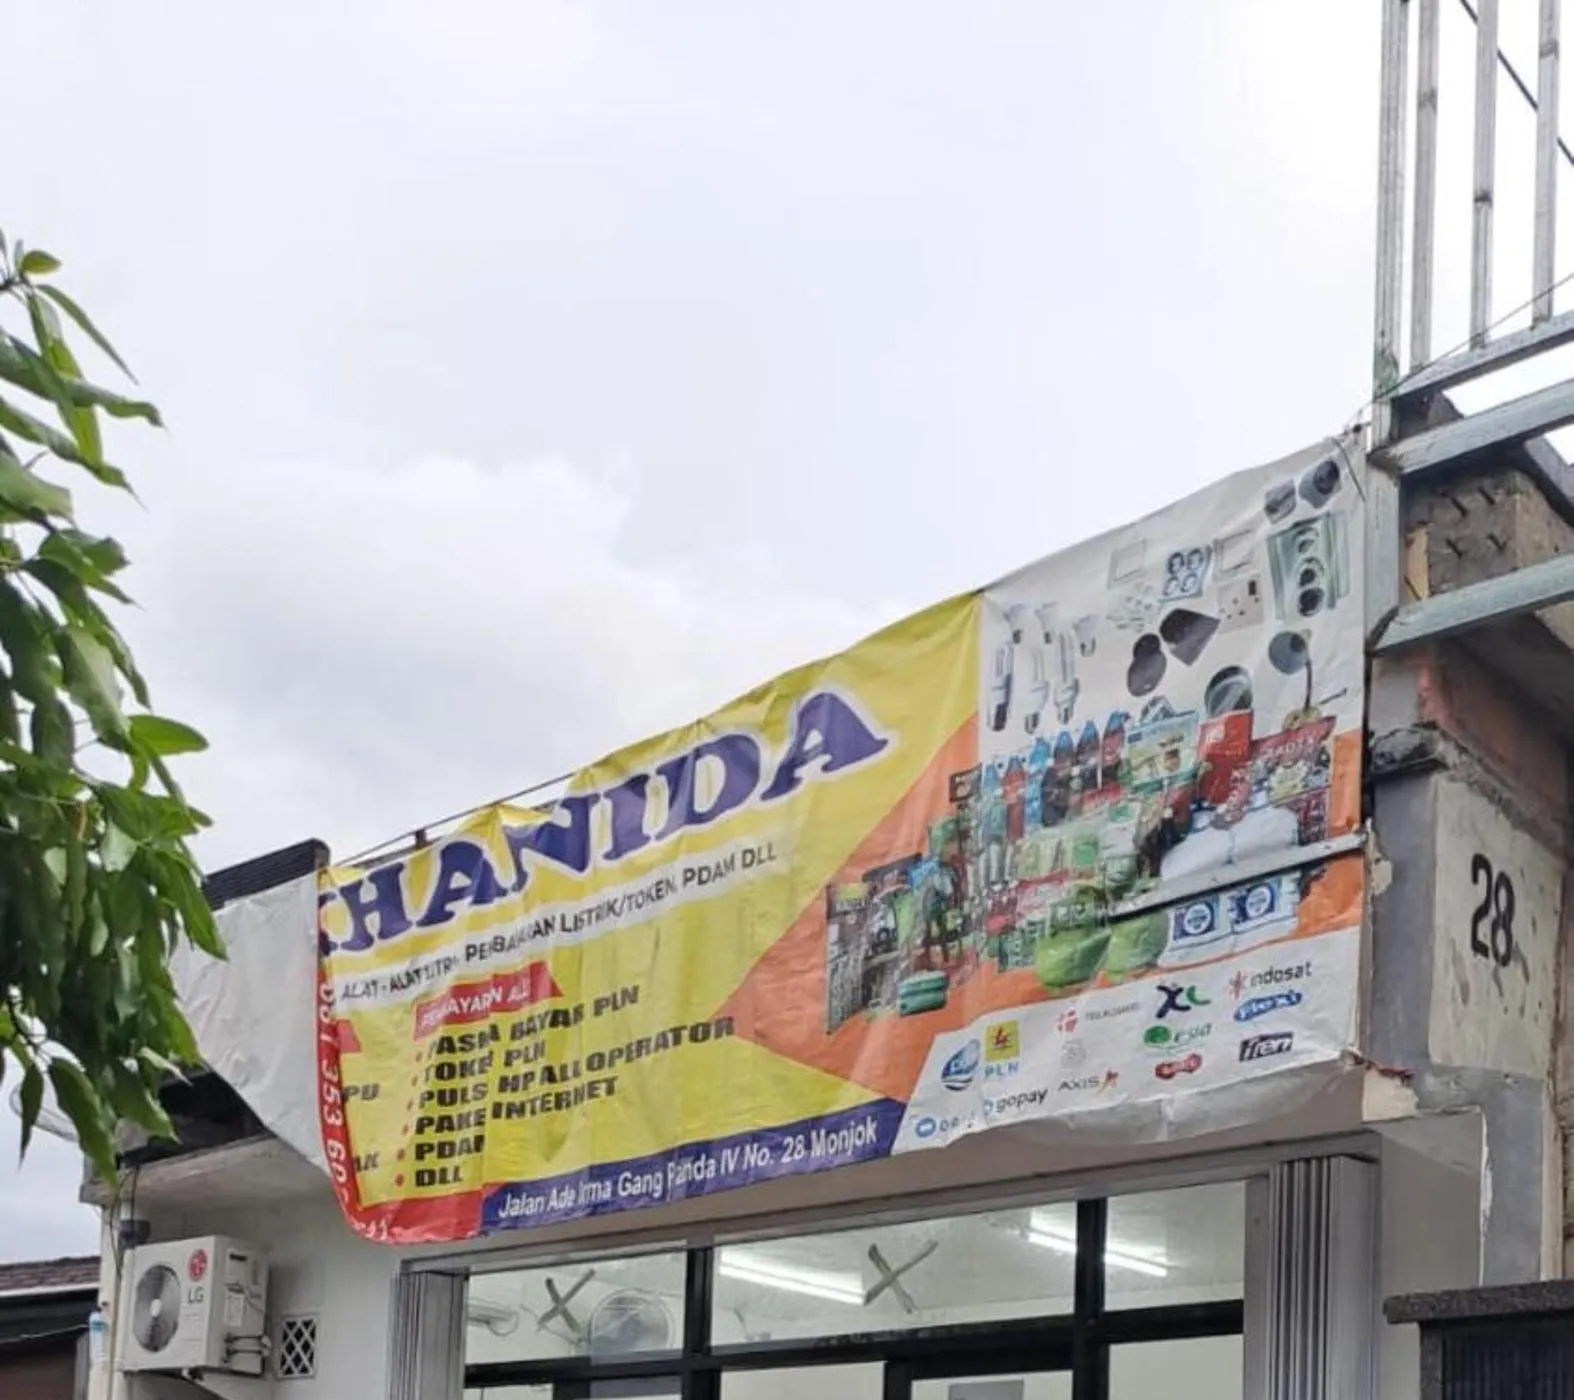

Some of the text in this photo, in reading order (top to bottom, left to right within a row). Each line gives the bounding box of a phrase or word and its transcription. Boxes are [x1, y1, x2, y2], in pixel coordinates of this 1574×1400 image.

[683, 853, 736, 888] PDAM
[741, 842, 778, 870] DLL
[1471, 853, 1516, 967] 28
[593, 985, 640, 1016] PLN
[586, 1016, 735, 1072] OPERATOR
[984, 1061, 1020, 1080] PLN
[492, 1076, 619, 1120] INTERNET
[415, 1165, 464, 1188] DLL
[498, 1189, 546, 1219] Jalan
[618, 1170, 664, 1199] Gang
[667, 1153, 717, 1190] Panda
[720, 1147, 740, 1176] IV
[743, 1142, 775, 1171] No.
[781, 1134, 806, 1165] 28
[810, 1115, 879, 1159] Monjok
[187, 1286, 205, 1304] LG
